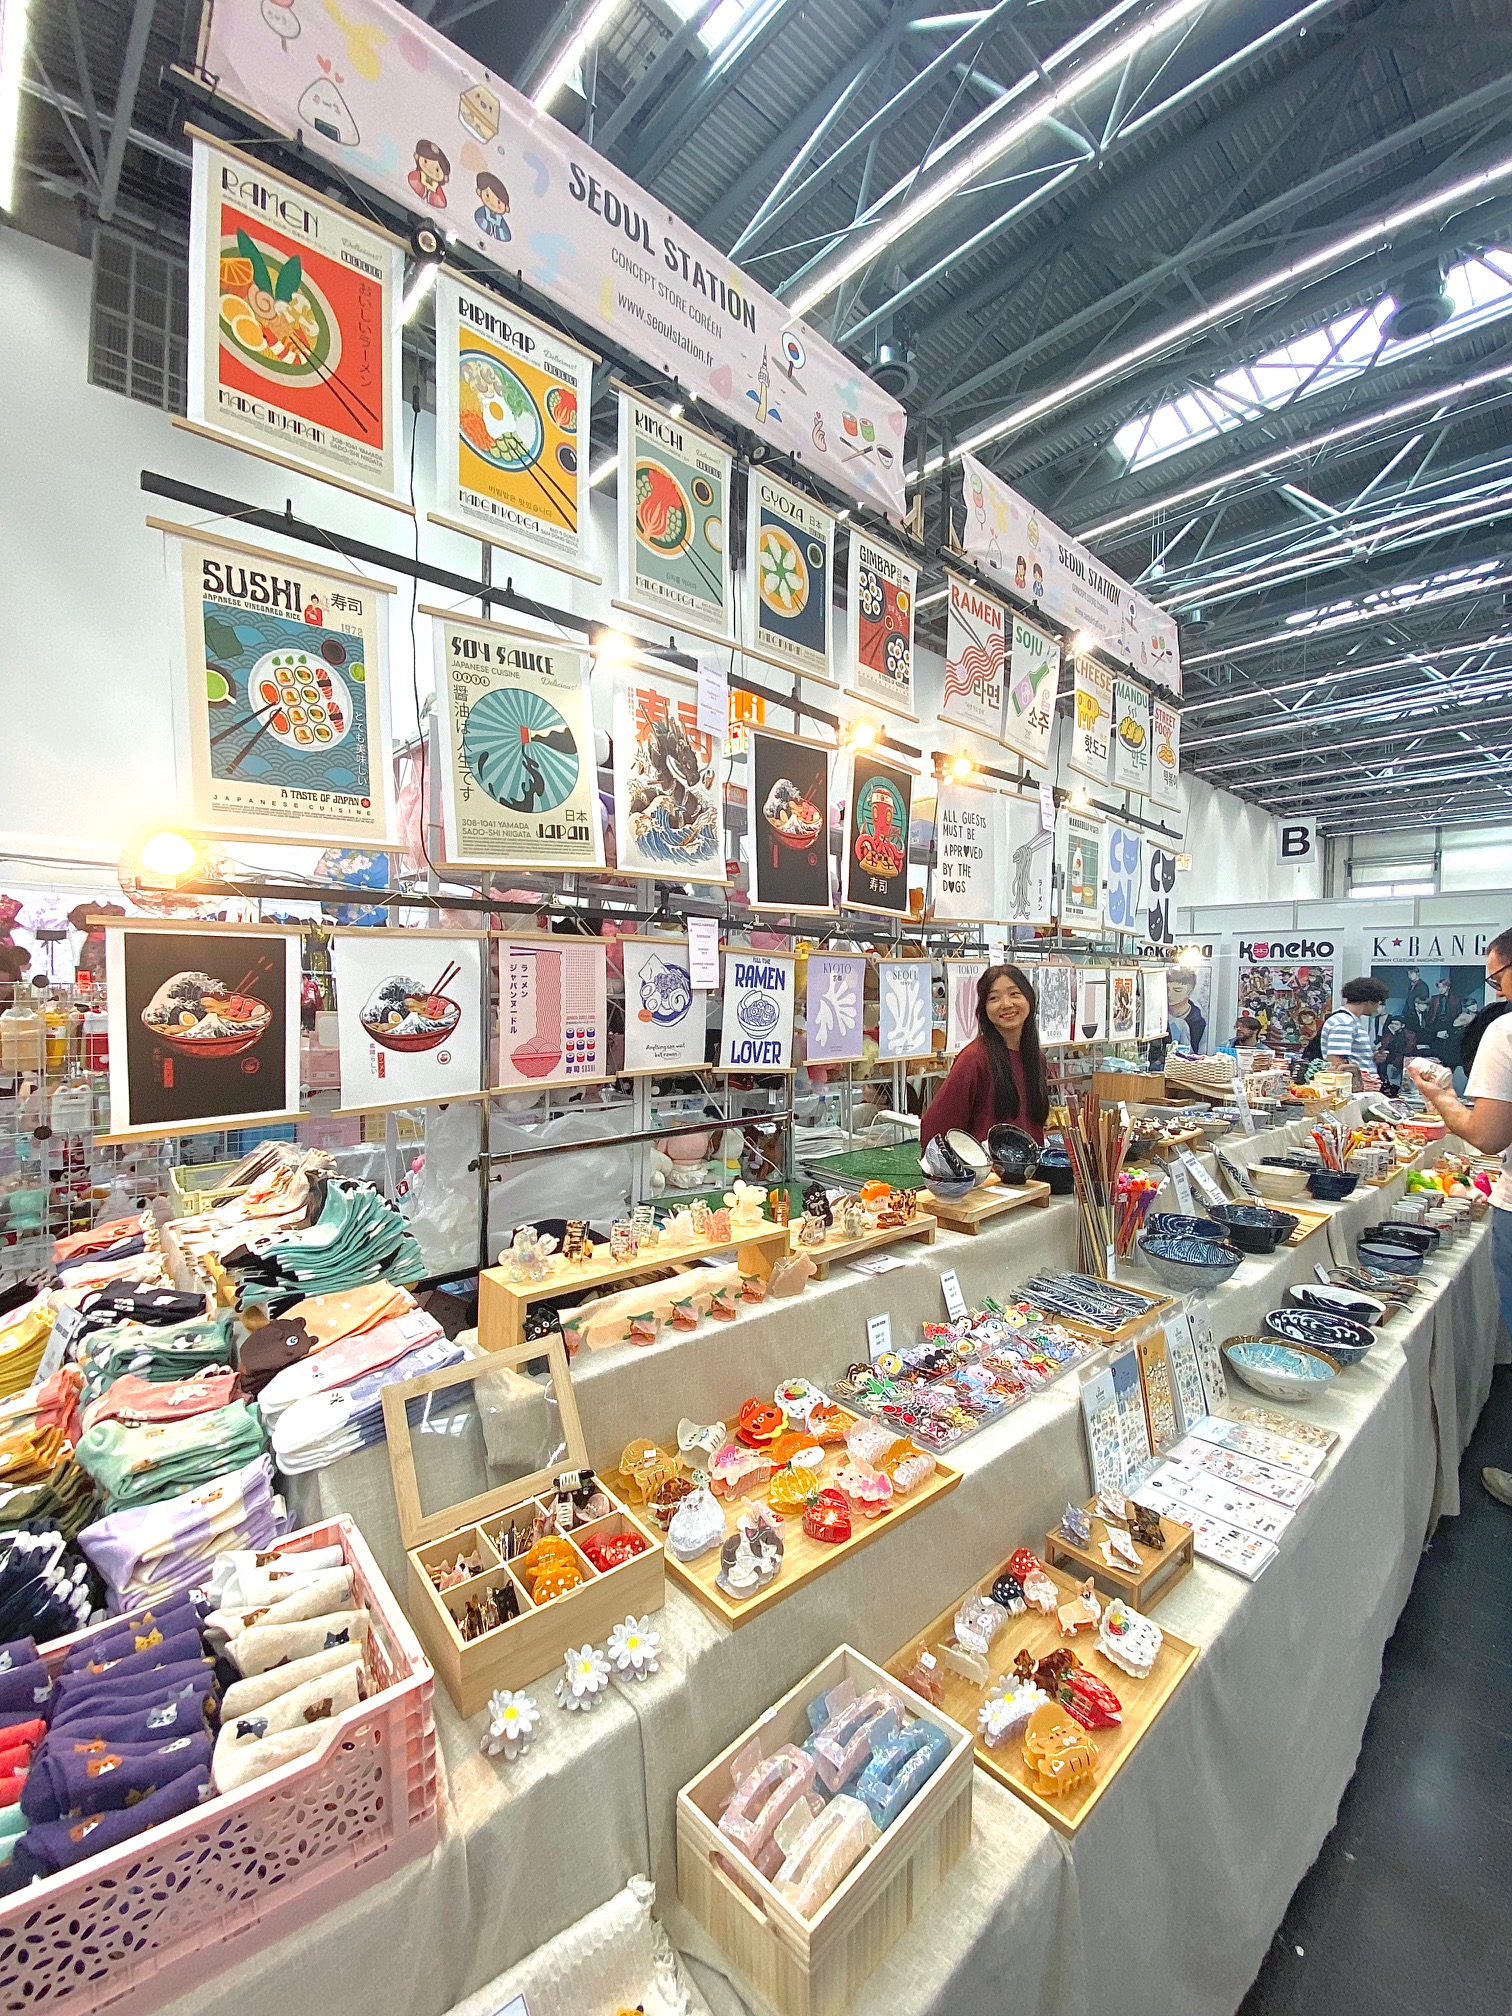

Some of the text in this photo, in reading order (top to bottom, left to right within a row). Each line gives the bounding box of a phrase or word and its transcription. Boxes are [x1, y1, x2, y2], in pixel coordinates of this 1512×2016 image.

[221, 166, 319, 239] RAMEN
[568, 162, 756, 334] SEOUL STATION
[611, 247, 722, 340] CONCEPT STORE CORÉEN
[459, 296, 535, 354] BIBIMBAP
[219, 389, 264, 420] MADE
[268, 409, 280, 431] IN
[281, 416, 326, 445] JAPAN
[635, 409, 683, 452] KIMCHI
[459, 489, 490, 512] MADE
[501, 506, 539, 532] KOREA
[761, 485, 804, 523] GYOZA
[859, 544, 897, 579] GIMBAP
[202, 558, 302, 613] SUSHI
[1058, 544, 1086, 582] SEOUL
[1088, 567, 1121, 608] STATION
[202, 592, 301, 621] JAPANESE VINEGARED RICE
[330, 592, 363, 616] 寿司
[951, 584, 1002, 631] RAMEN
[340, 623, 364, 637] 1972
[1016, 626, 1043, 657] SOJU
[452, 636, 555, 676] SOY SAUCE
[452, 659, 521, 680] JAPANESE CUISINE
[1076, 656, 1112, 693] CHEESE
[973, 679, 1001, 711] 라면
[1117, 681, 1148, 708] MANDU
[1028, 706, 1050, 735] 소주
[1155, 708, 1176, 730] STREET
[1084, 734, 1107, 760] 핫도그
[1131, 750, 1148, 772] 만두
[281, 788, 360, 807] A TASTE OF JAPAN
[462, 818, 530, 830] 308-1041 YAMADA
[565, 809, 588, 823] 日本
[943, 809, 987, 829] ALL GUESTS
[462, 827, 501, 837] SADO-SHI
[943, 824, 976, 840] MUST BE
[1281, 827, 1310, 857] B
[943, 862, 972, 878] BY THE
[869, 877, 888, 894] 寿司
[1372, 937, 1389, 957] K
[735, 963, 785, 991] RAMEN
[823, 963, 852, 974] KYOTO
[892, 970, 919, 980] SEOUL
[957, 964, 979, 975] TOKYO
[731, 1040, 782, 1065] LOVER
